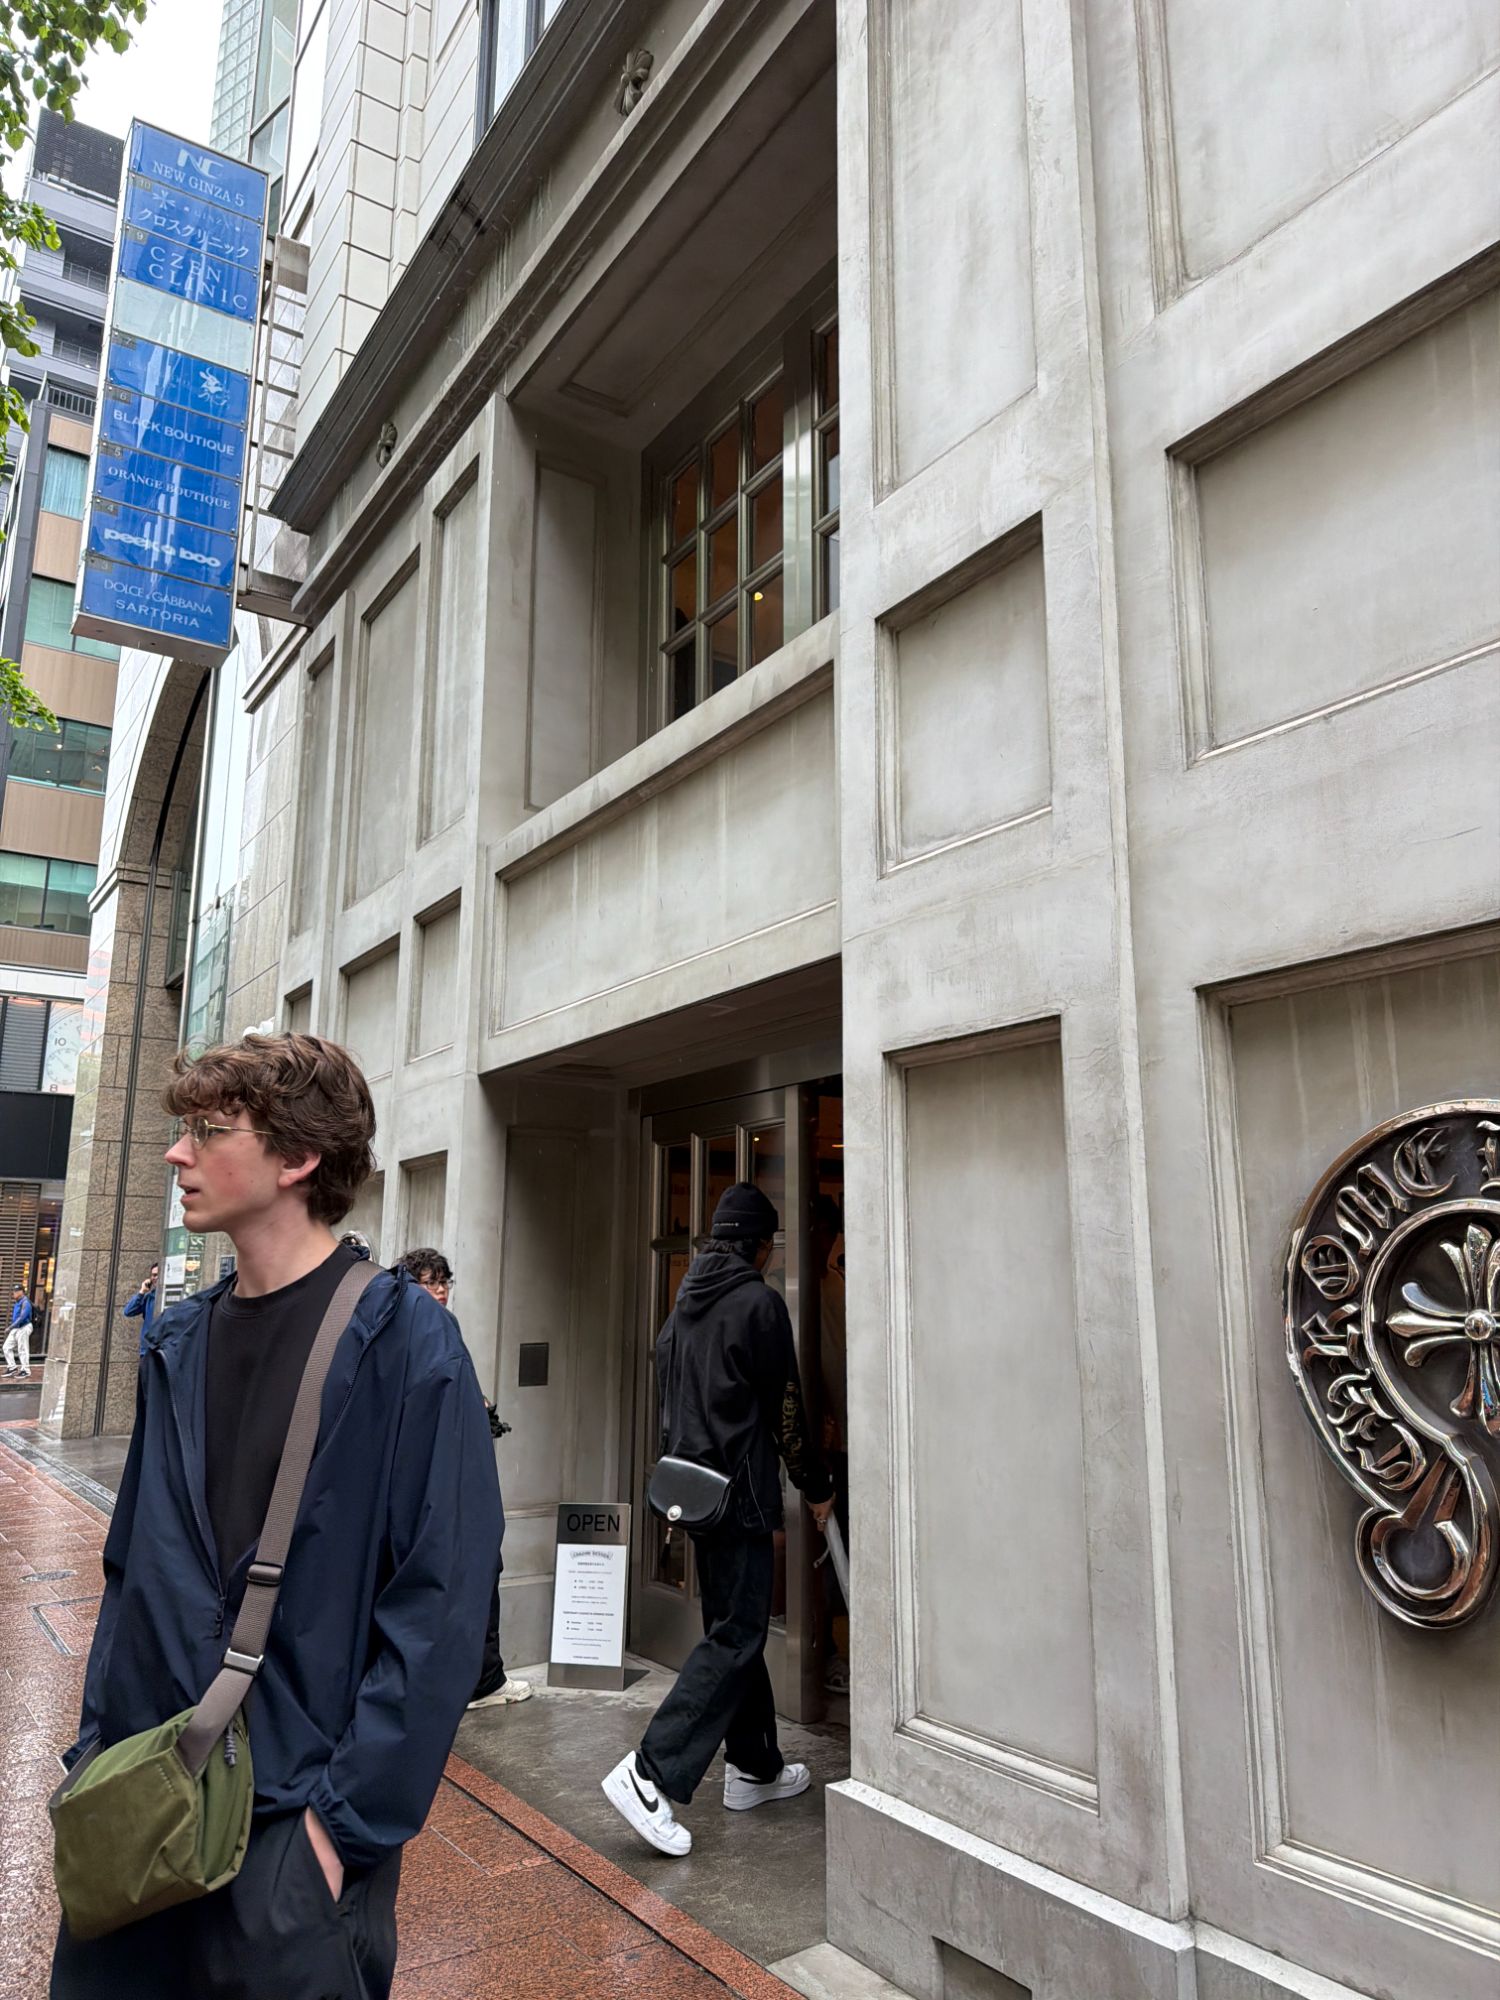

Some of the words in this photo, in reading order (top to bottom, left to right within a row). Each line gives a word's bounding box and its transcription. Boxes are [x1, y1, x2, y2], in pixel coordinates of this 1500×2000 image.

[152, 161, 187, 184] NEW
[188, 175, 231, 202] GINZA
[234, 193, 245, 207] 5
[136, 231, 144, 240] 9
[139, 208, 249, 258] クロスクリニック
[150, 246, 222, 283] CZEN
[148, 263, 248, 310] CLINIC
[113, 408, 161, 433] BLACK
[164, 426, 235, 455] BOUTIQUE
[108, 465, 163, 490] ORANGE
[165, 484, 231, 510] BOUTIQUE
[179, 547, 221, 568] boo
[104, 578, 144, 599] DOLCE
[152, 591, 214, 616] GABBANA
[116, 599, 200, 628] SARTORIA
[566, 1513, 621, 1532] OPEN
